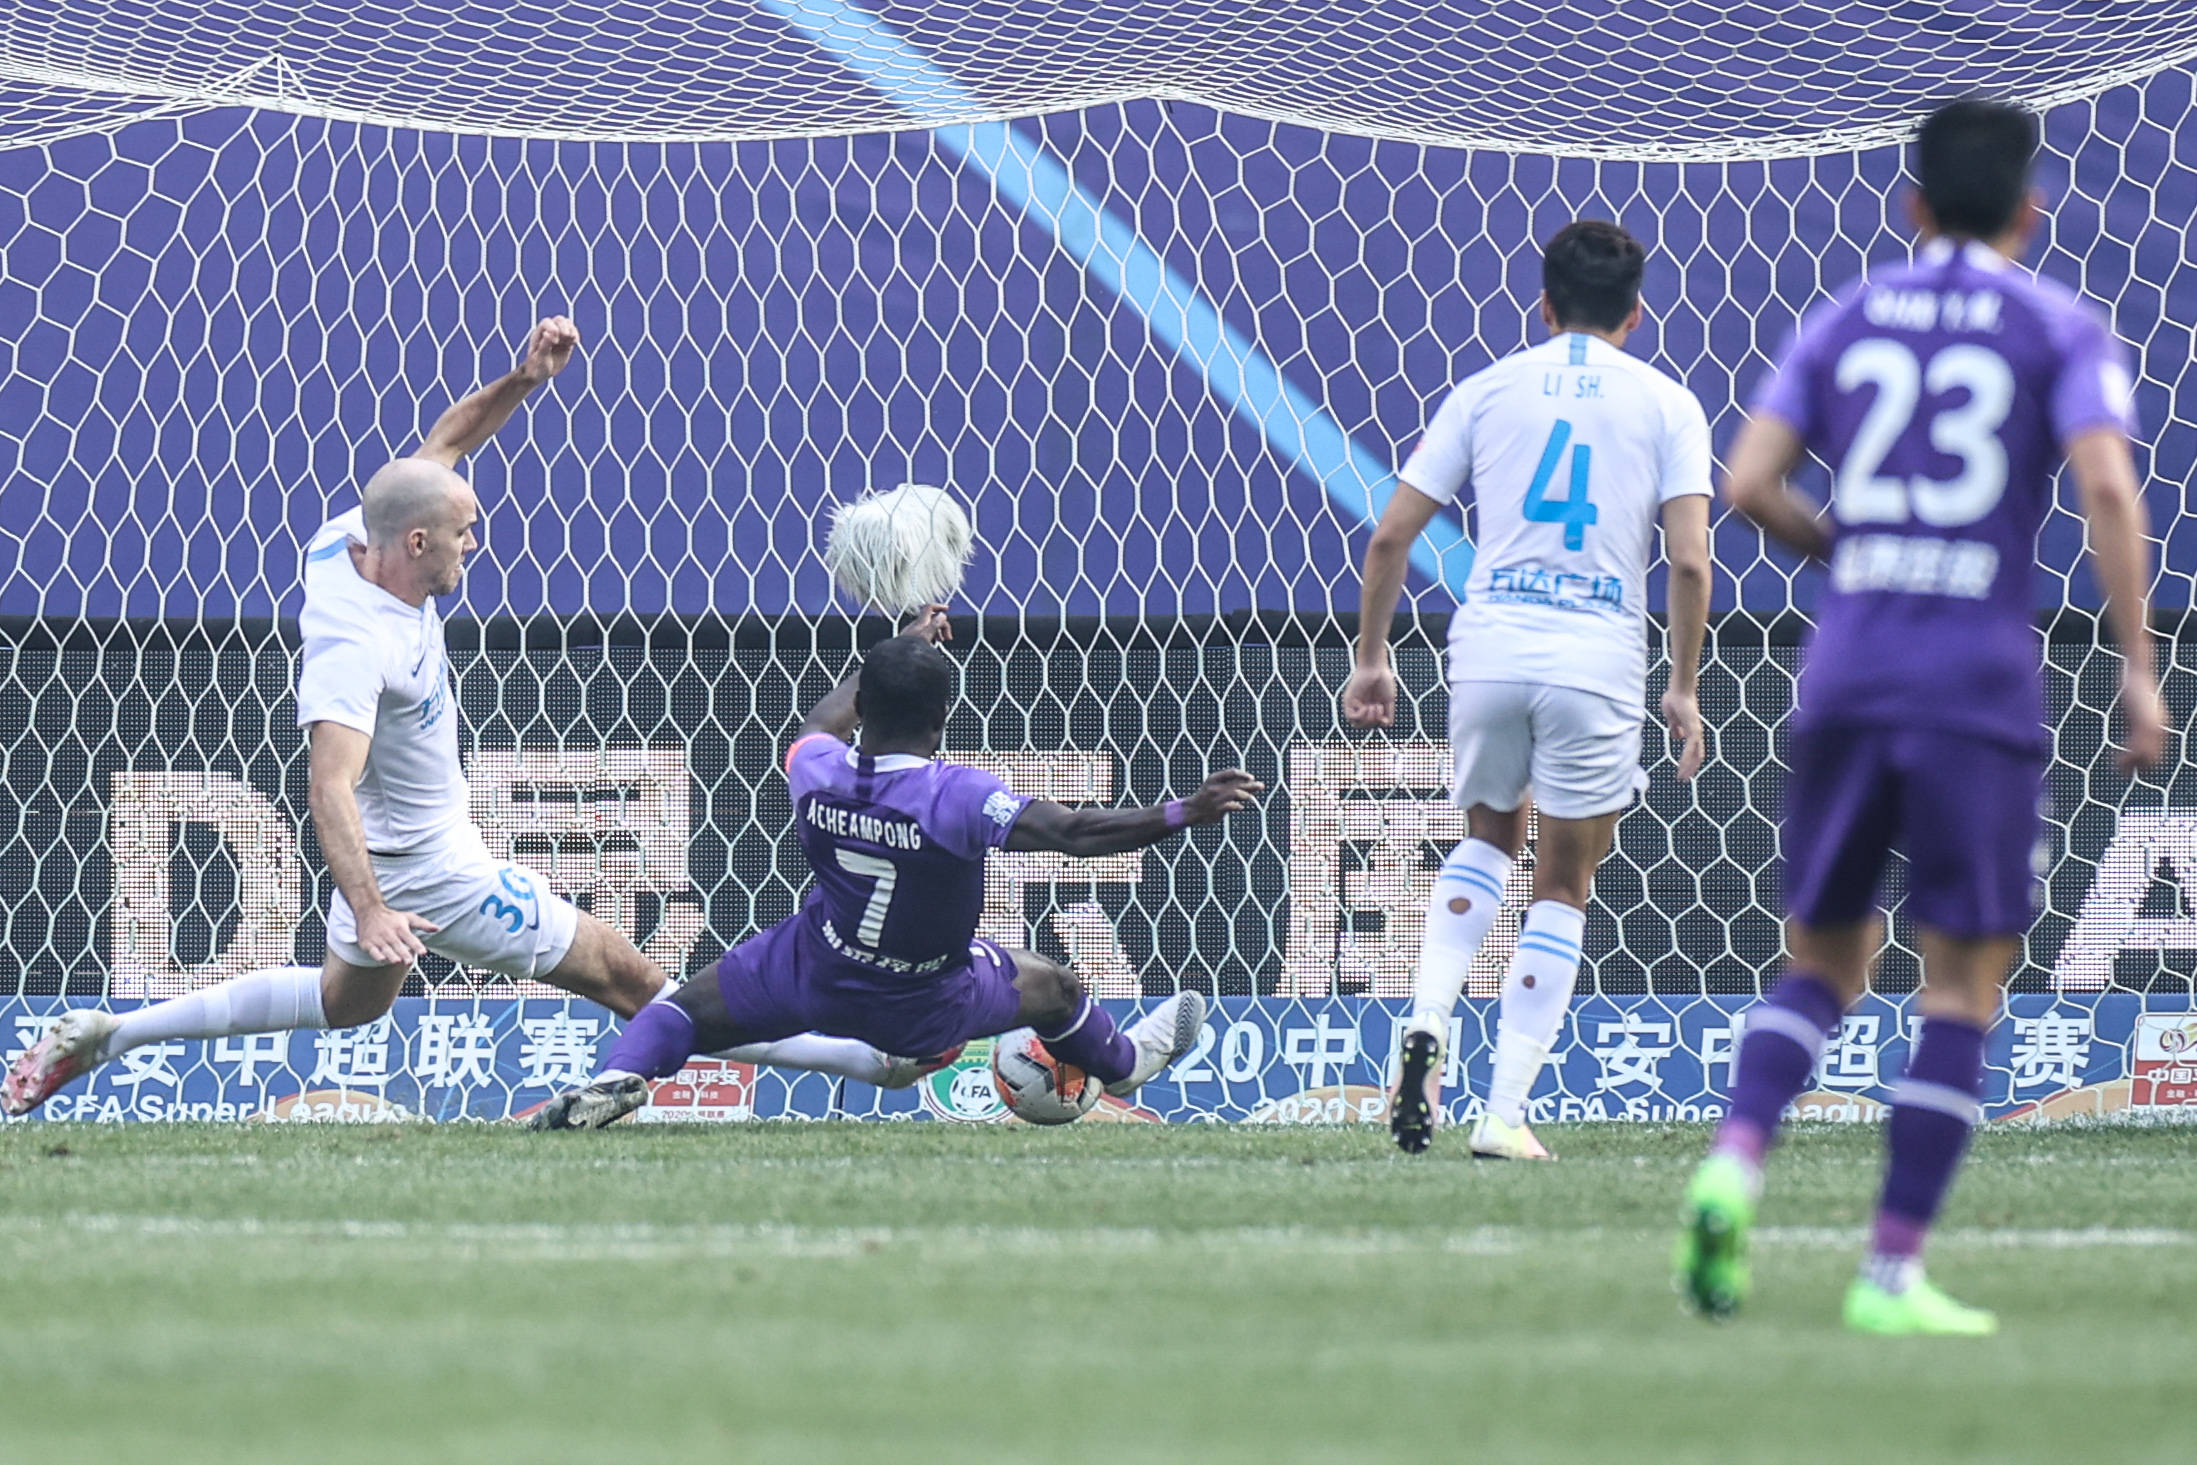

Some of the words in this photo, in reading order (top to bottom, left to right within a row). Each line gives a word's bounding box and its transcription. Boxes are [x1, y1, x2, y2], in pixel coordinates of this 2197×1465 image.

[1543, 373, 1561, 397] LI
[1834, 338, 2015, 527] 23
[1523, 418, 1597, 551] 4
[807, 798, 922, 850] ACHEAMPONG
[835, 848, 897, 948] 7
[44, 1094, 124, 1122] CFA
[1527, 1098, 1612, 1124] CFA
